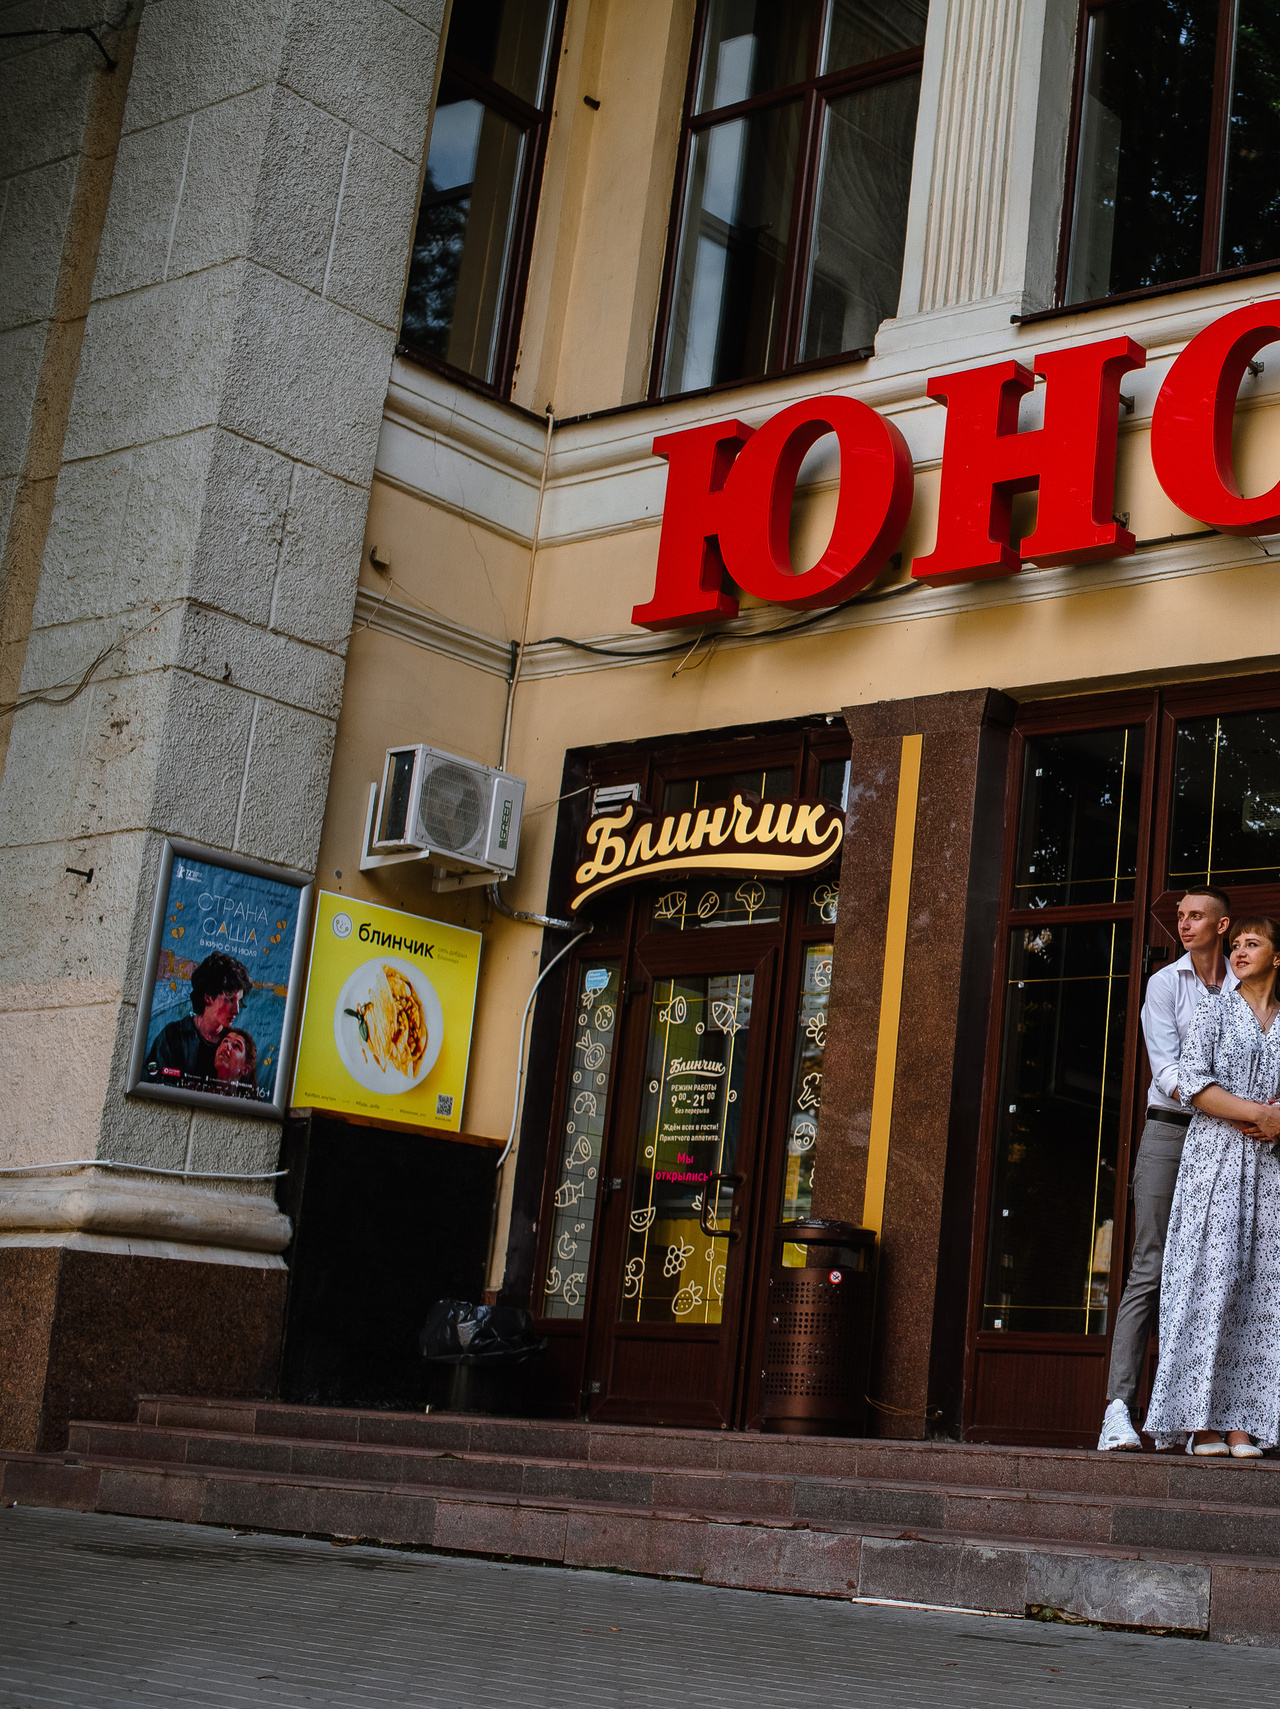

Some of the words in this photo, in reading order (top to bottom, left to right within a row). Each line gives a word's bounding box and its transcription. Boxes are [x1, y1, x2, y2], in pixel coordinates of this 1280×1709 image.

[571, 794, 844, 910] Блинчик
[197, 892, 269, 926] СТРАНА
[202, 917, 258, 946] САША
[358, 922, 435, 959] блинчик
[199, 938, 205, 946] В
[205, 940, 223, 950] КИНО
[231, 945, 238, 953] 14
[238, 947, 258, 957] ИЮЛЯ
[666, 1057, 726, 1081] Блинчик
[256, 1086, 271, 1098] 16+
[693, 1083, 718, 1091] РАБОТЫ
[674, 1107, 684, 1115] Без
[685, 1108, 710, 1116] перерыва
[663, 1122, 681, 1132] Ждём
[700, 1122, 719, 1131] гости!
[677, 1152, 694, 1164] Мы
